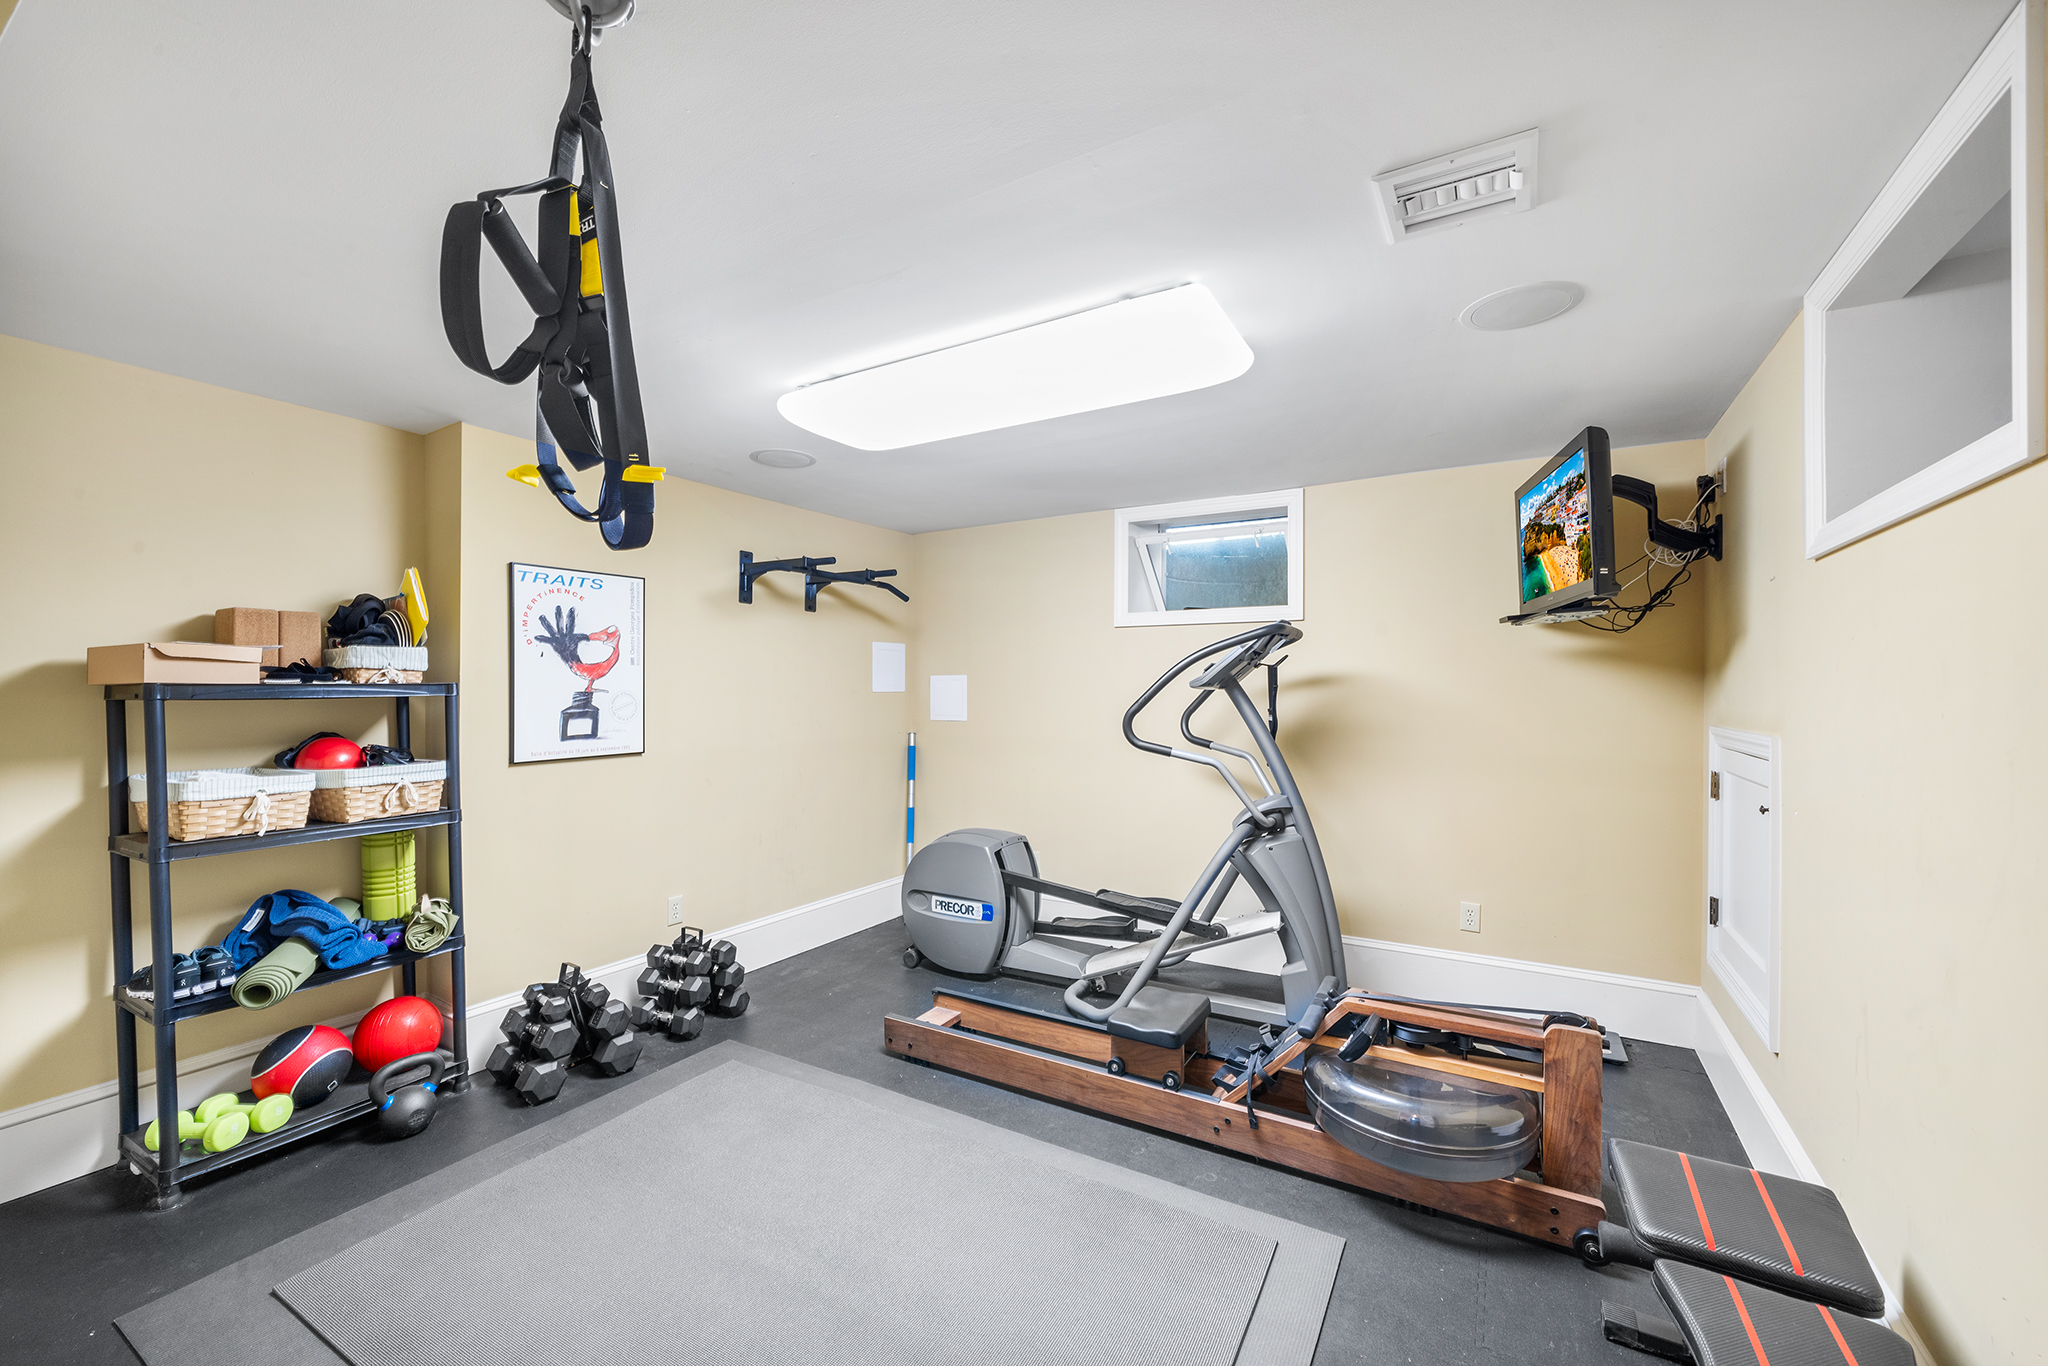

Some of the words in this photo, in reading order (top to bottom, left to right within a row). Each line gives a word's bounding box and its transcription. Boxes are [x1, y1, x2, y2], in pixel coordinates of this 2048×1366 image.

[580, 219, 595, 234] TR
[518, 570, 604, 590] TRAITS
[935, 900, 974, 916] PRECOR
